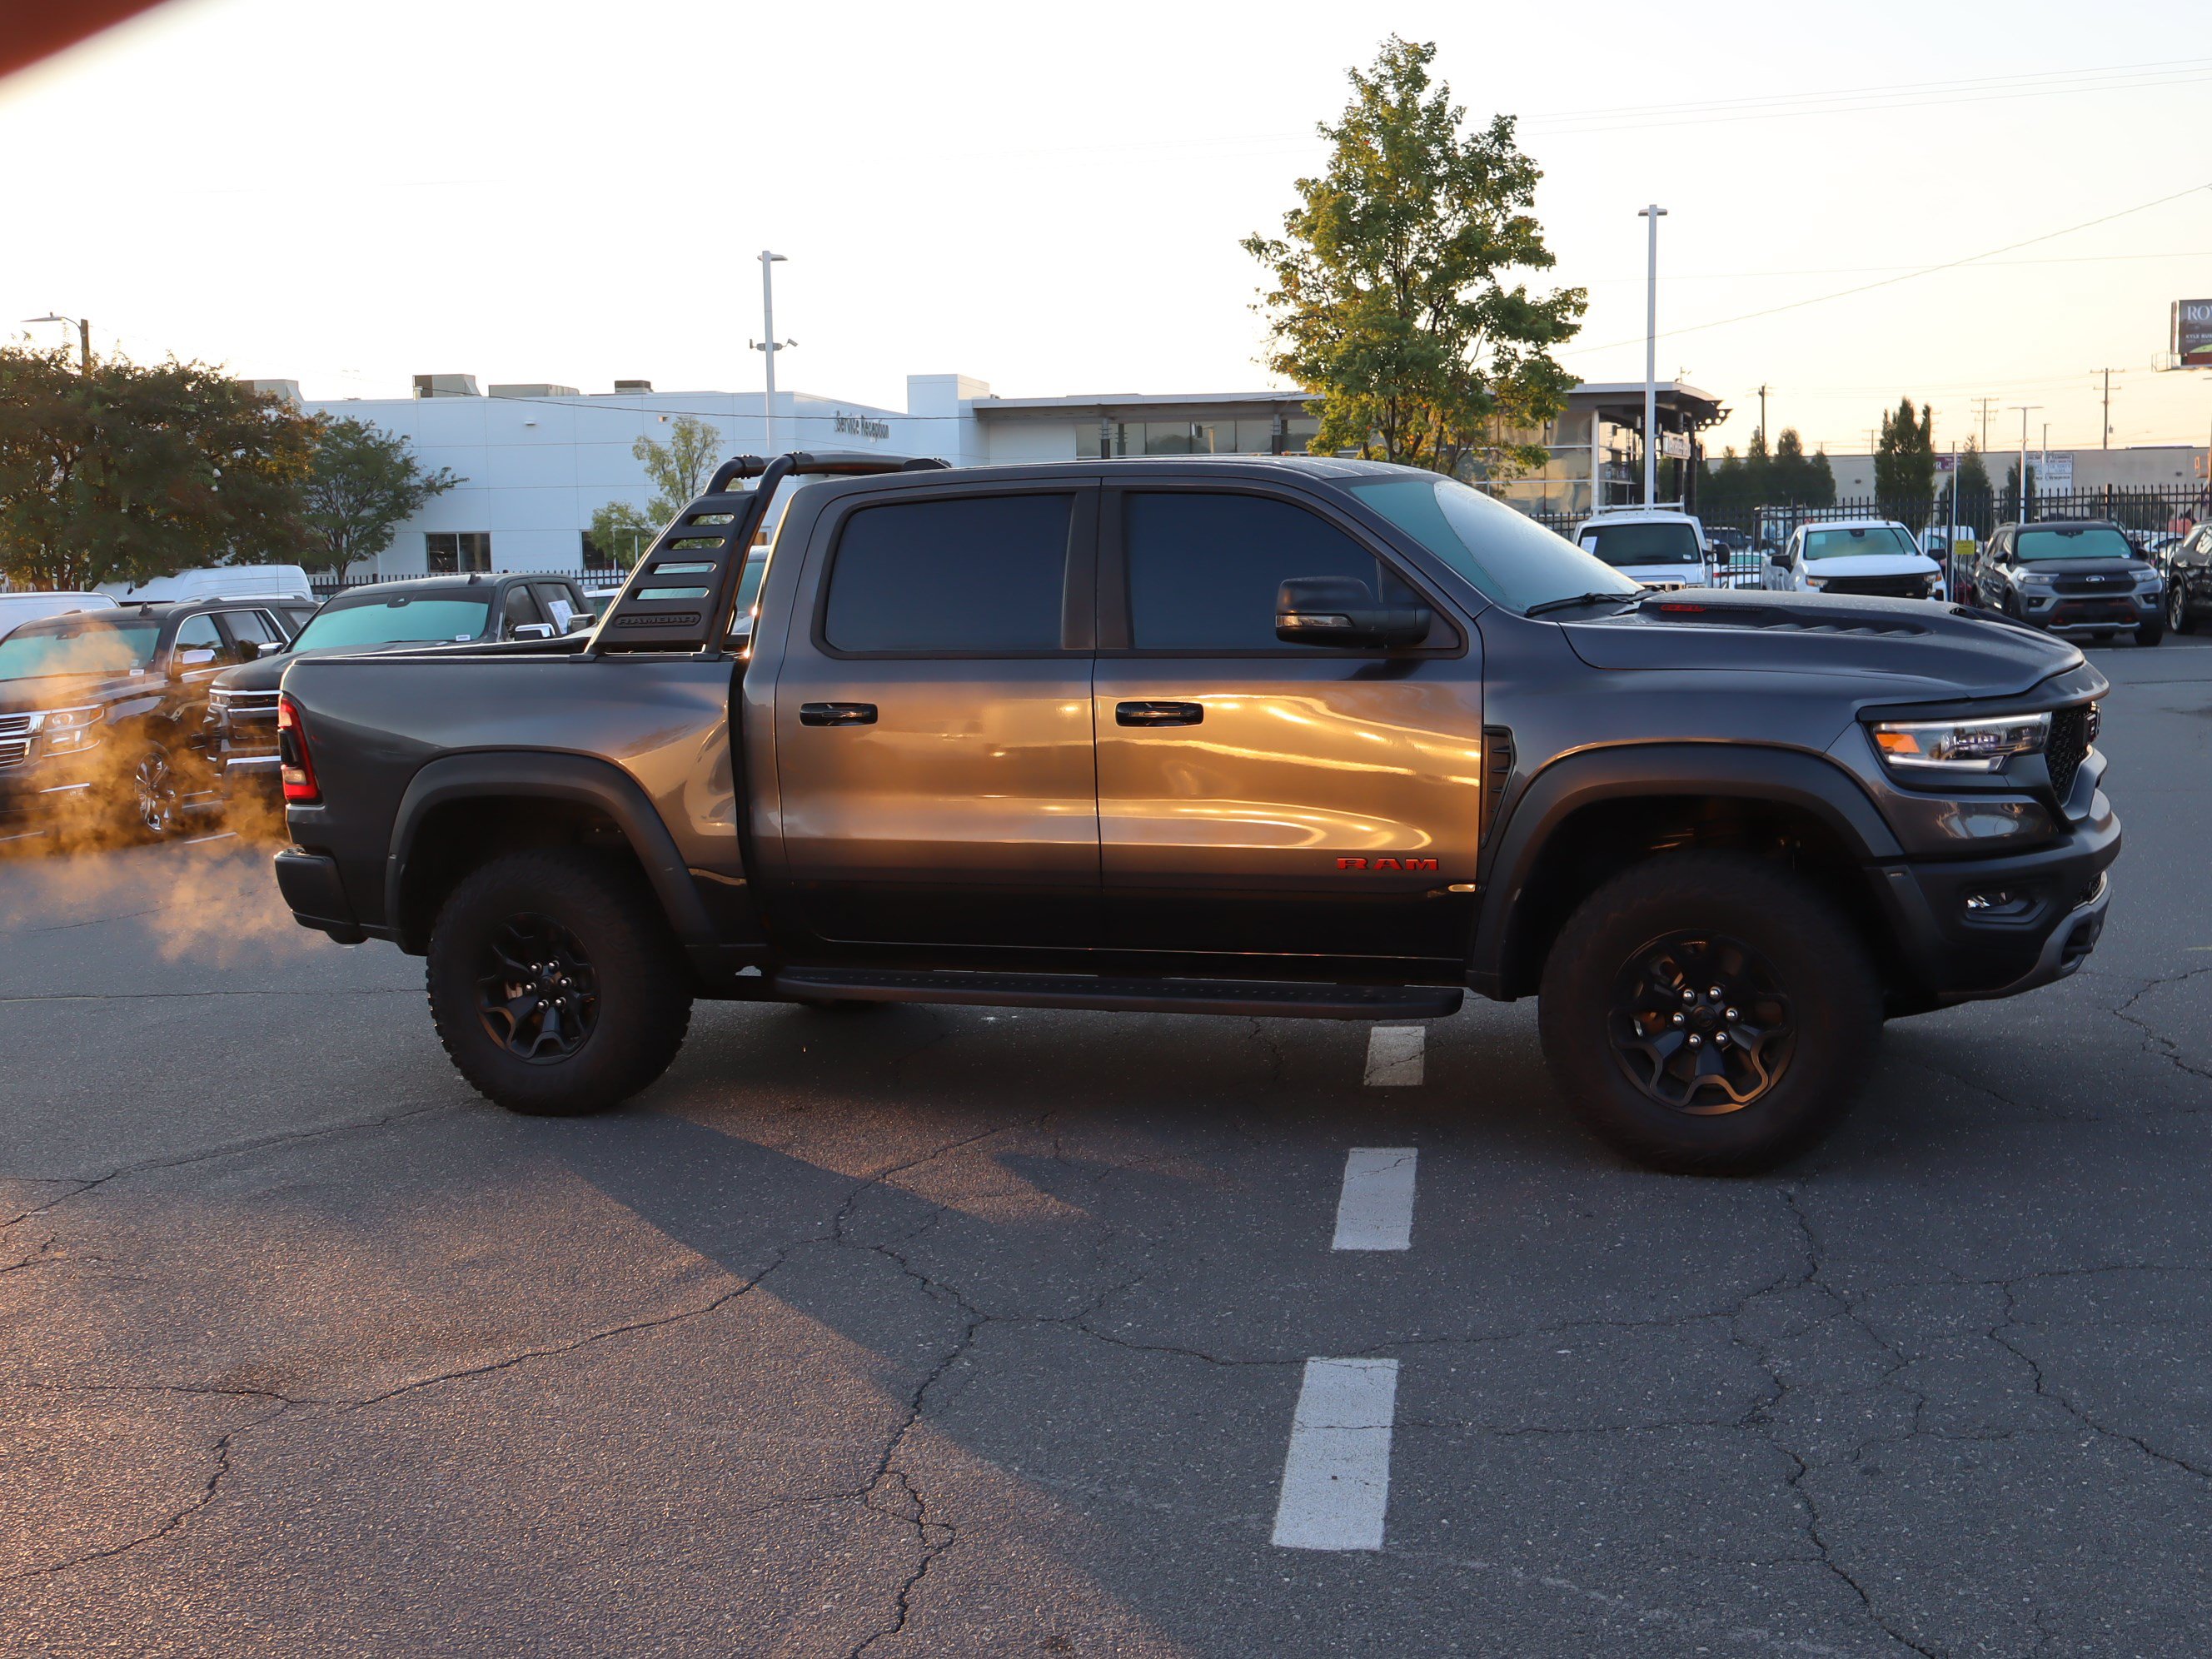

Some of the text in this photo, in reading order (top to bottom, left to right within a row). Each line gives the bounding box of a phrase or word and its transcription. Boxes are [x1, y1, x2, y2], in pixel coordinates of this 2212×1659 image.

[2187, 306, 2212, 321] RO
[835, 410, 889, 442] Service Reception
[618, 615, 696, 625] RAMBAR
[1337, 857, 1439, 870] RAM
